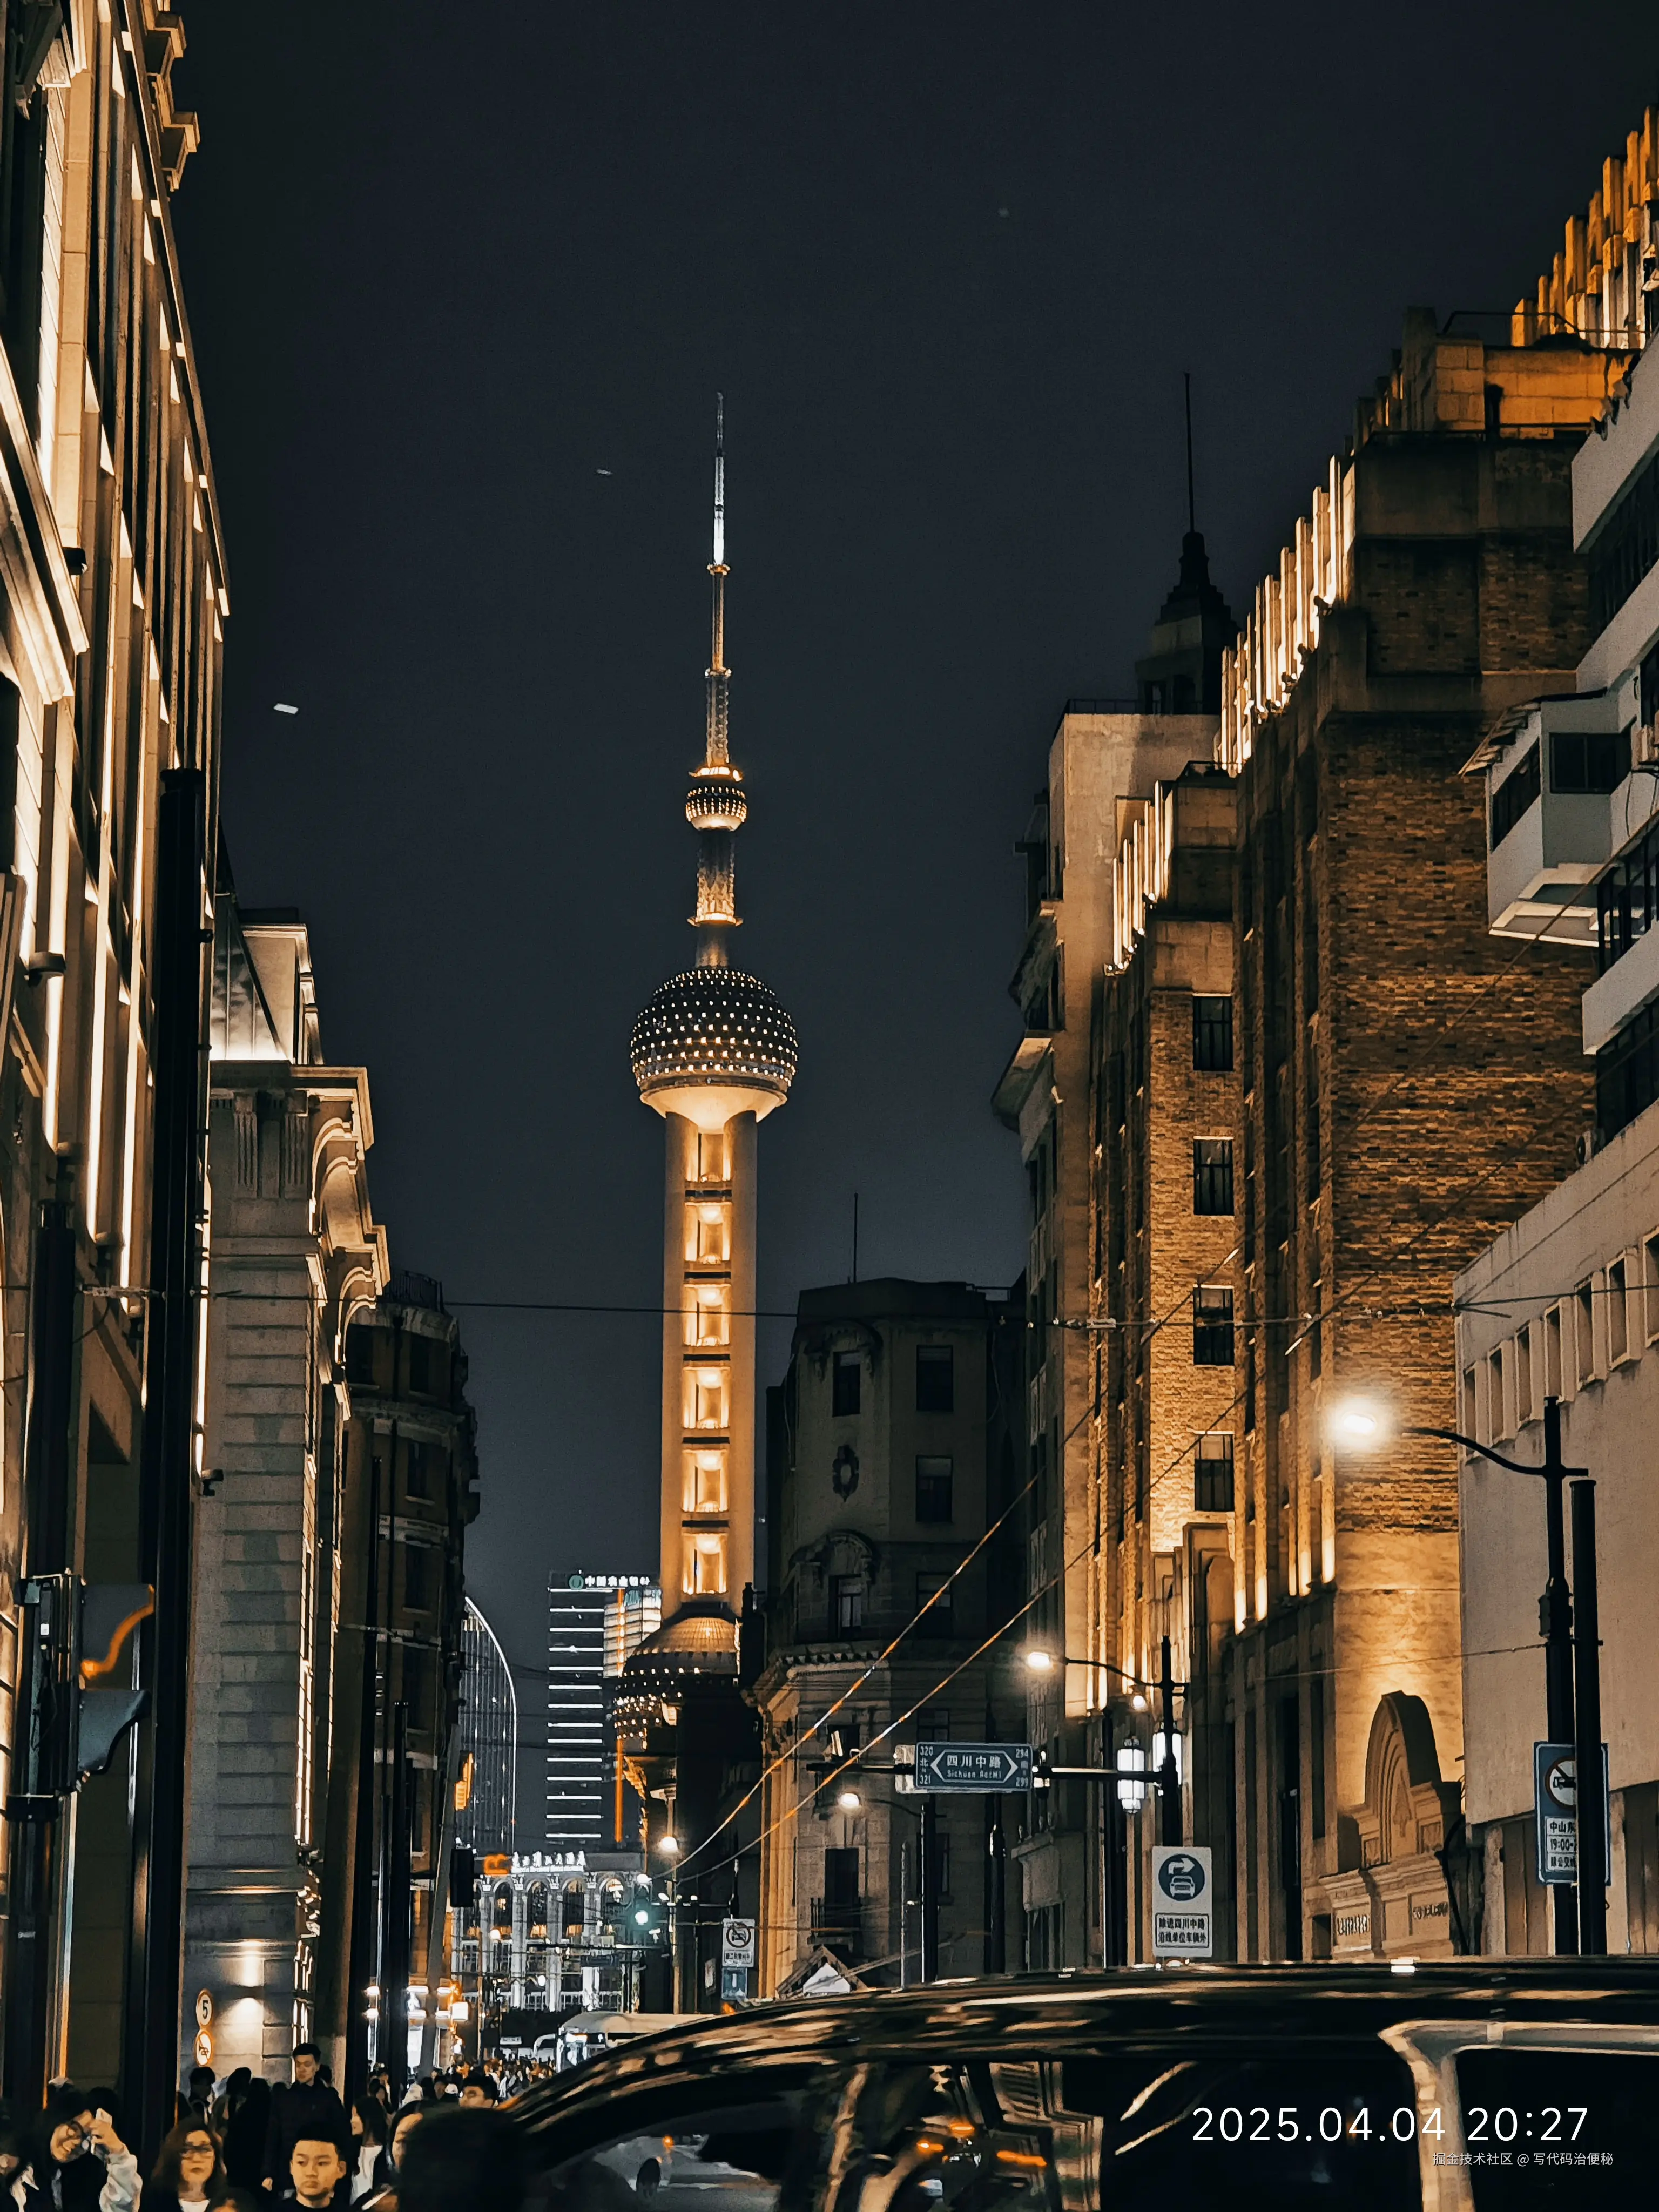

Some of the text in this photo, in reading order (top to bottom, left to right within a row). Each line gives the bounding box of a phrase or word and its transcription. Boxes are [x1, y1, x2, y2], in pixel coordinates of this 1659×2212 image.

[920, 1746, 933, 1756] 320
[947, 1755, 1001, 1769] 四川中路
[947, 1769, 976, 1778] Sichuan
[920, 1775, 931, 1785] 321
[202, 2000, 208, 2019] 5
